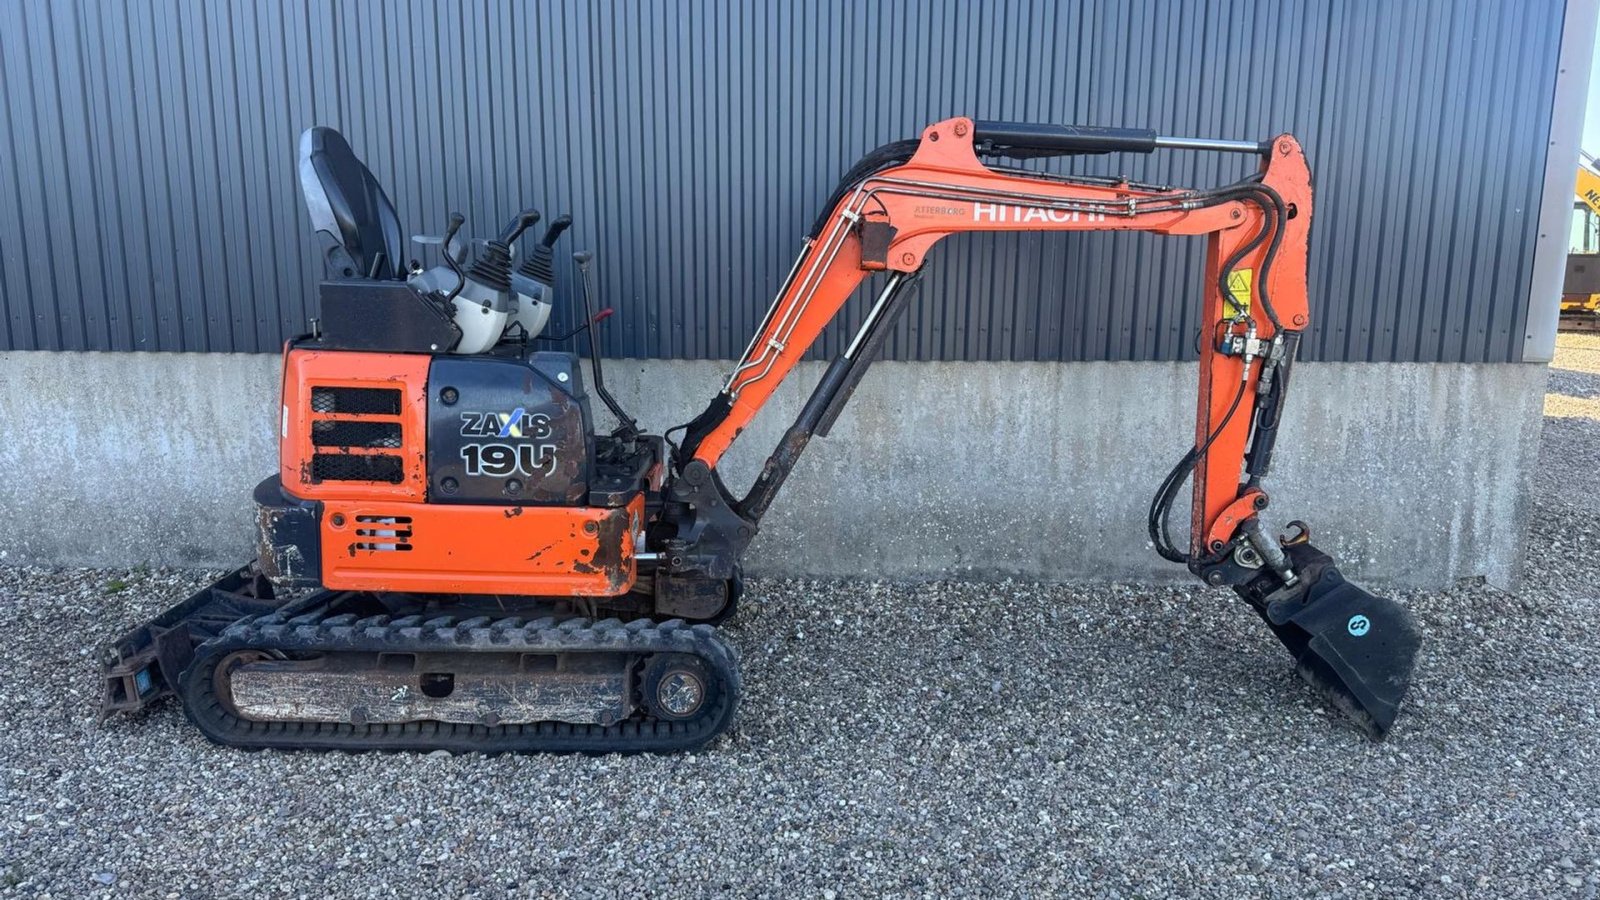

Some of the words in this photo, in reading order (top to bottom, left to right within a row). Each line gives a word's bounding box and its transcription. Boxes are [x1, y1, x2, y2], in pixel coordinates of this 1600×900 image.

[973, 200, 1105, 222] HITACHI
[1585, 189, 1600, 209] NE
[461, 408, 552, 439] ZAXIS
[460, 443, 557, 478] 19U
